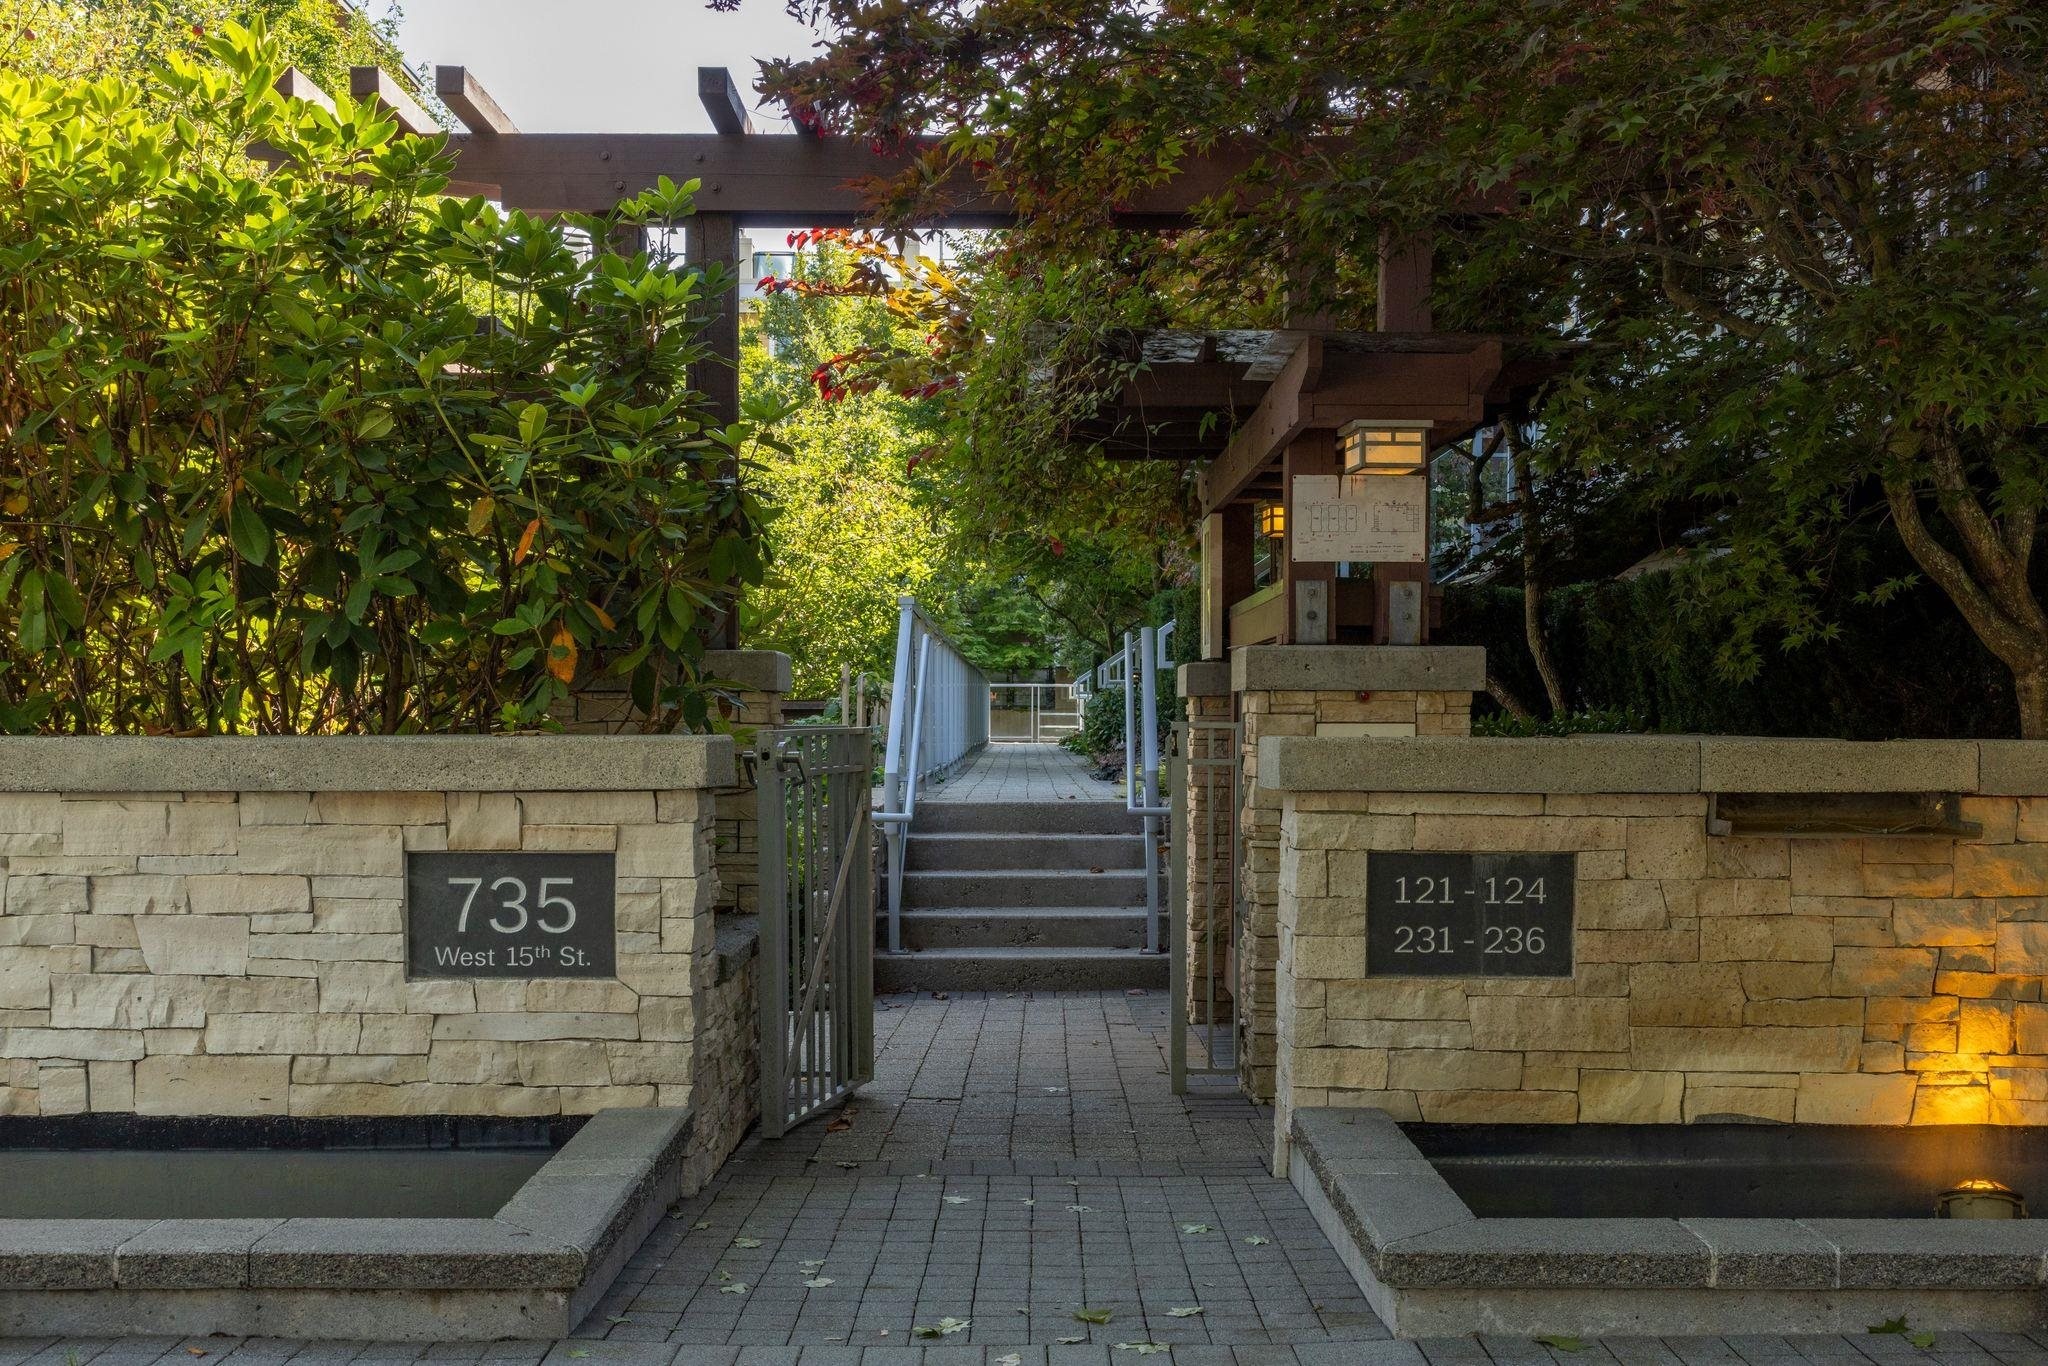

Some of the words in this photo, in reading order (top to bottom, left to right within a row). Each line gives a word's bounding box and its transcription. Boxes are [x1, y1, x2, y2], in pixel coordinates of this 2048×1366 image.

[1395, 877, 1454, 904] 121
[1485, 877, 1547, 904] 124
[448, 877, 577, 933] 735
[1394, 926, 1454, 953] 231
[1484, 926, 1546, 954] 236
[435, 946, 496, 966] West
[506, 945, 551, 966] 15th
[559, 946, 591, 966] St.
